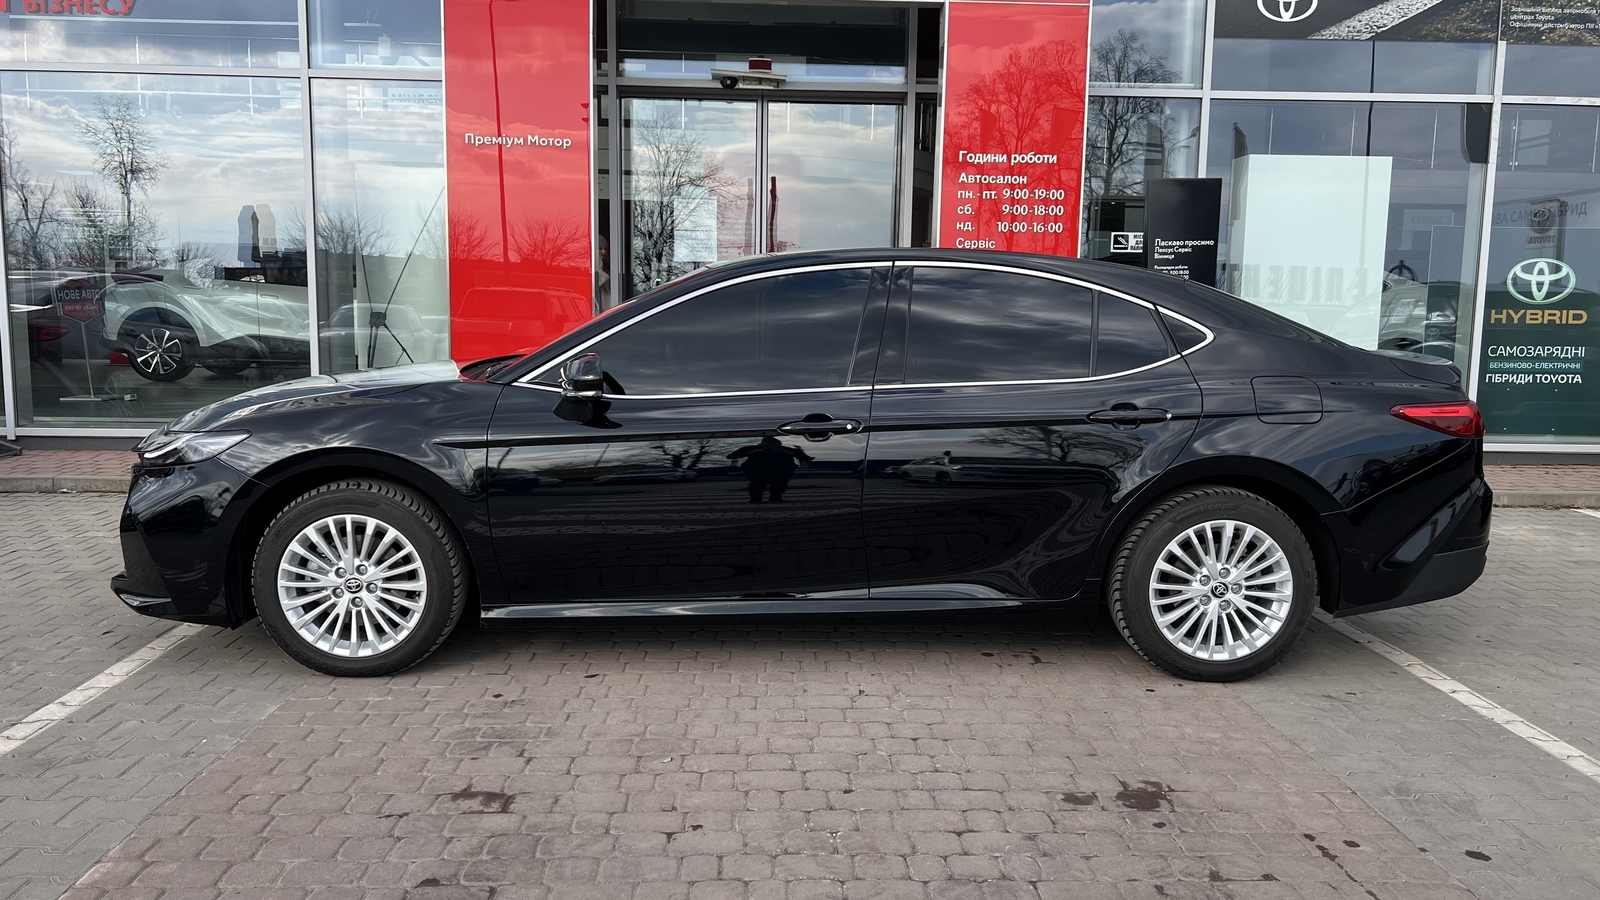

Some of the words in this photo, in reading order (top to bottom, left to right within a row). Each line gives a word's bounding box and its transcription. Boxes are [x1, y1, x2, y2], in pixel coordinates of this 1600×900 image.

[1535, 13, 1555, 22] Toyota
[464, 132, 524, 148] Преміум
[527, 134, 572, 149] Мотор
[958, 150, 1007, 164] Години
[1010, 151, 1058, 166] роботи
[958, 172, 1028, 185] Автосалон
[1002, 188, 1065, 200] 9:00-19:00
[957, 203, 975, 215] сб.
[1001, 203, 1064, 216] 9:00-18:00
[956, 221, 976, 232] нд.
[996, 221, 1063, 233] 10:00-16:00
[955, 237, 996, 249] Сервіс
[1154, 238, 1184, 247] Ласкаво
[57, 289, 81, 300] НОВЕ
[1490, 309, 1588, 325] HYBRID
[1487, 345, 1585, 359] САМОЗАРЯДНІ
[1489, 361, 1581, 370] БЕНЗИНОВО-ЕЛЕКТРИЧНІ
[1485, 373, 1533, 384] ГІБРИДИ
[1535, 374, 1582, 384] TOYOTA
